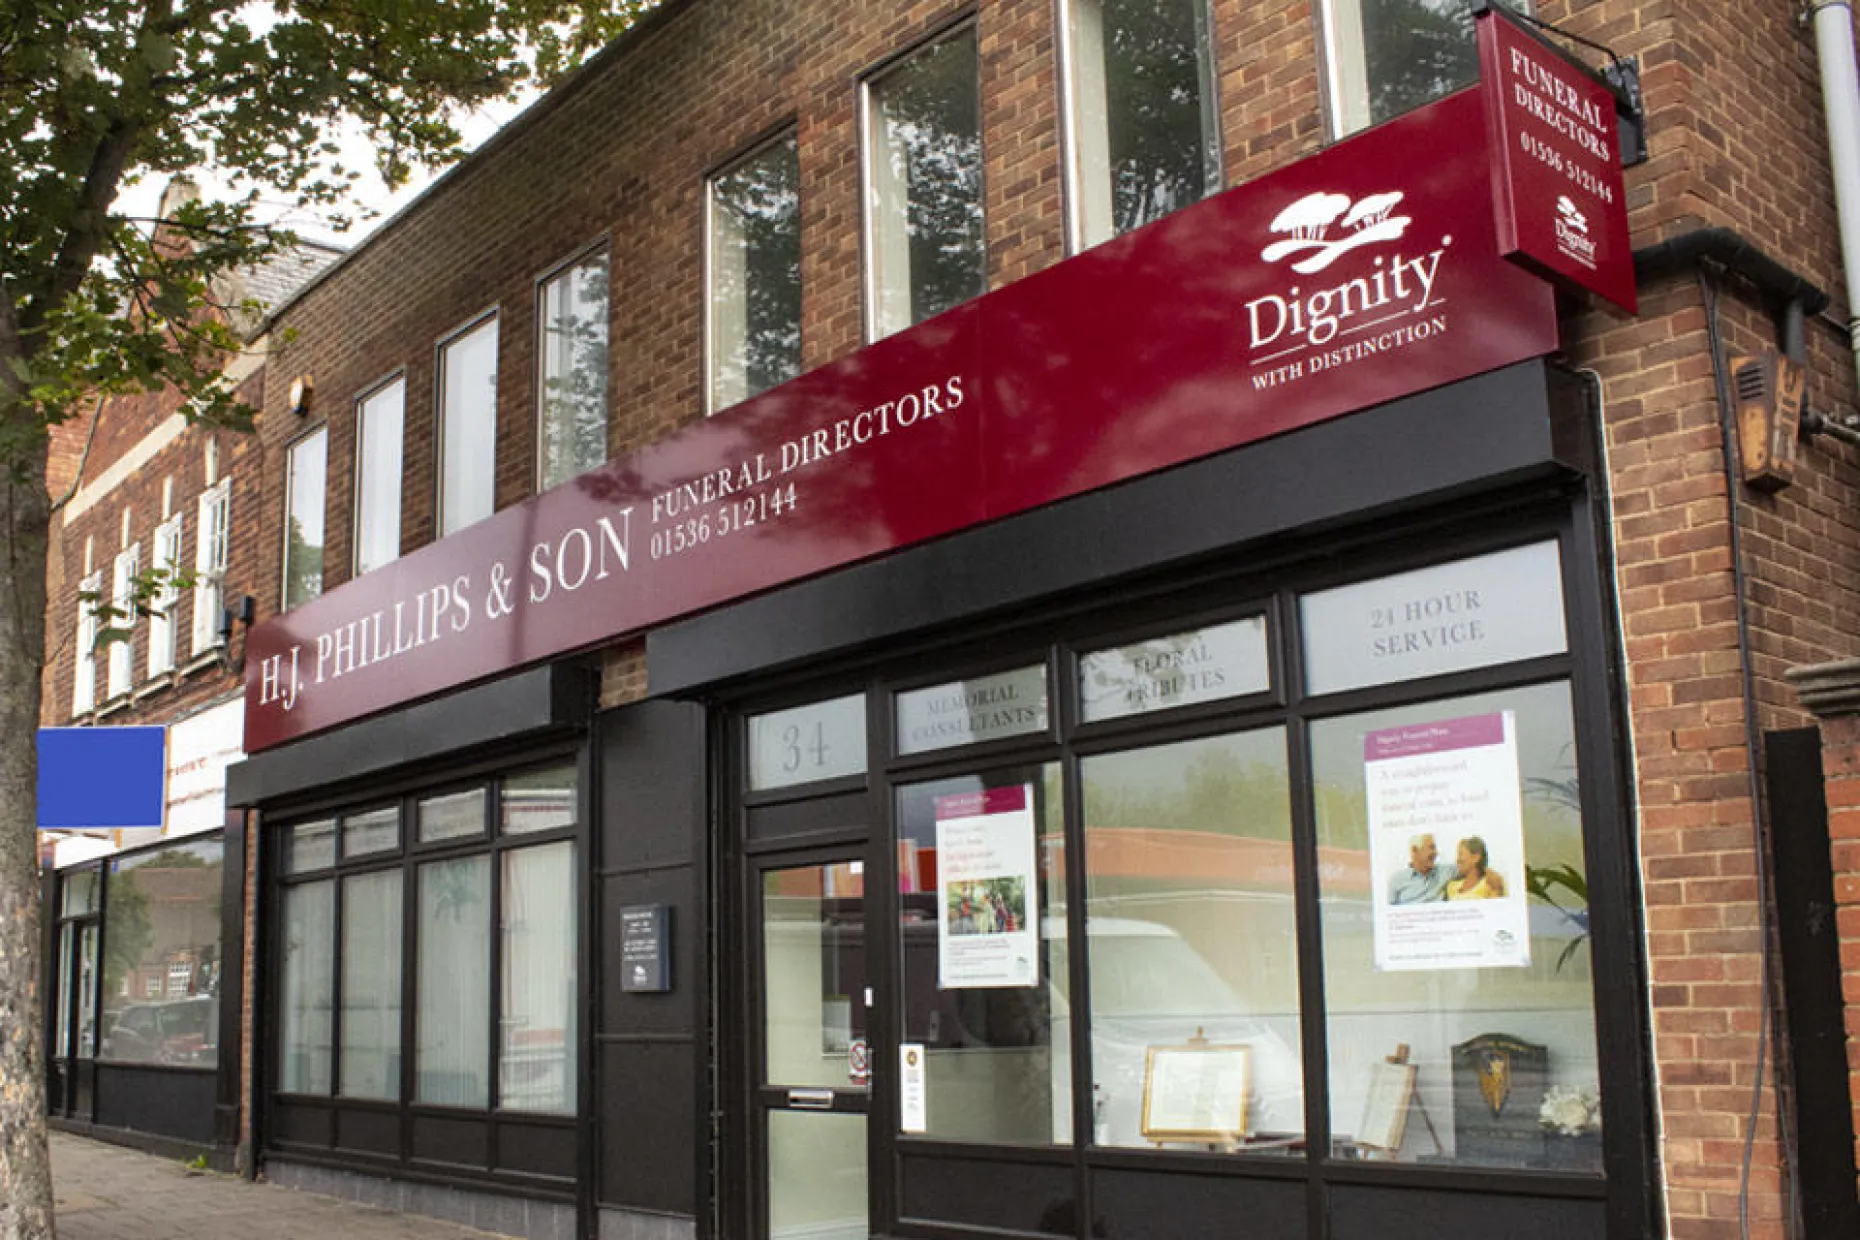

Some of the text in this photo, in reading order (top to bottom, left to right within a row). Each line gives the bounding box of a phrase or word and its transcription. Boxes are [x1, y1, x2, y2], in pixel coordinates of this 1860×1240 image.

[1510, 46, 1608, 133] FUNERAL
[1514, 82, 1611, 162] DIRECTORS
[1520, 131, 1613, 204] 01536 512144
[1554, 217, 1598, 262] Dignity
[1244, 249, 1444, 345] Dignity
[1251, 315, 1447, 391] WITH DISTINCTION
[651, 375, 965, 524] FUNERAL DIRECTORS
[650, 482, 797, 561] 01536 512144
[314, 574, 472, 684] PHILLIPS
[485, 560, 515, 620] &
[528, 506, 635, 604] SON
[1405, 589, 1481, 621] HOUR
[1372, 619, 1486, 658] SERVICE
[925, 682, 1021, 715] MEMORIAL
[782, 720, 831, 773] 34
